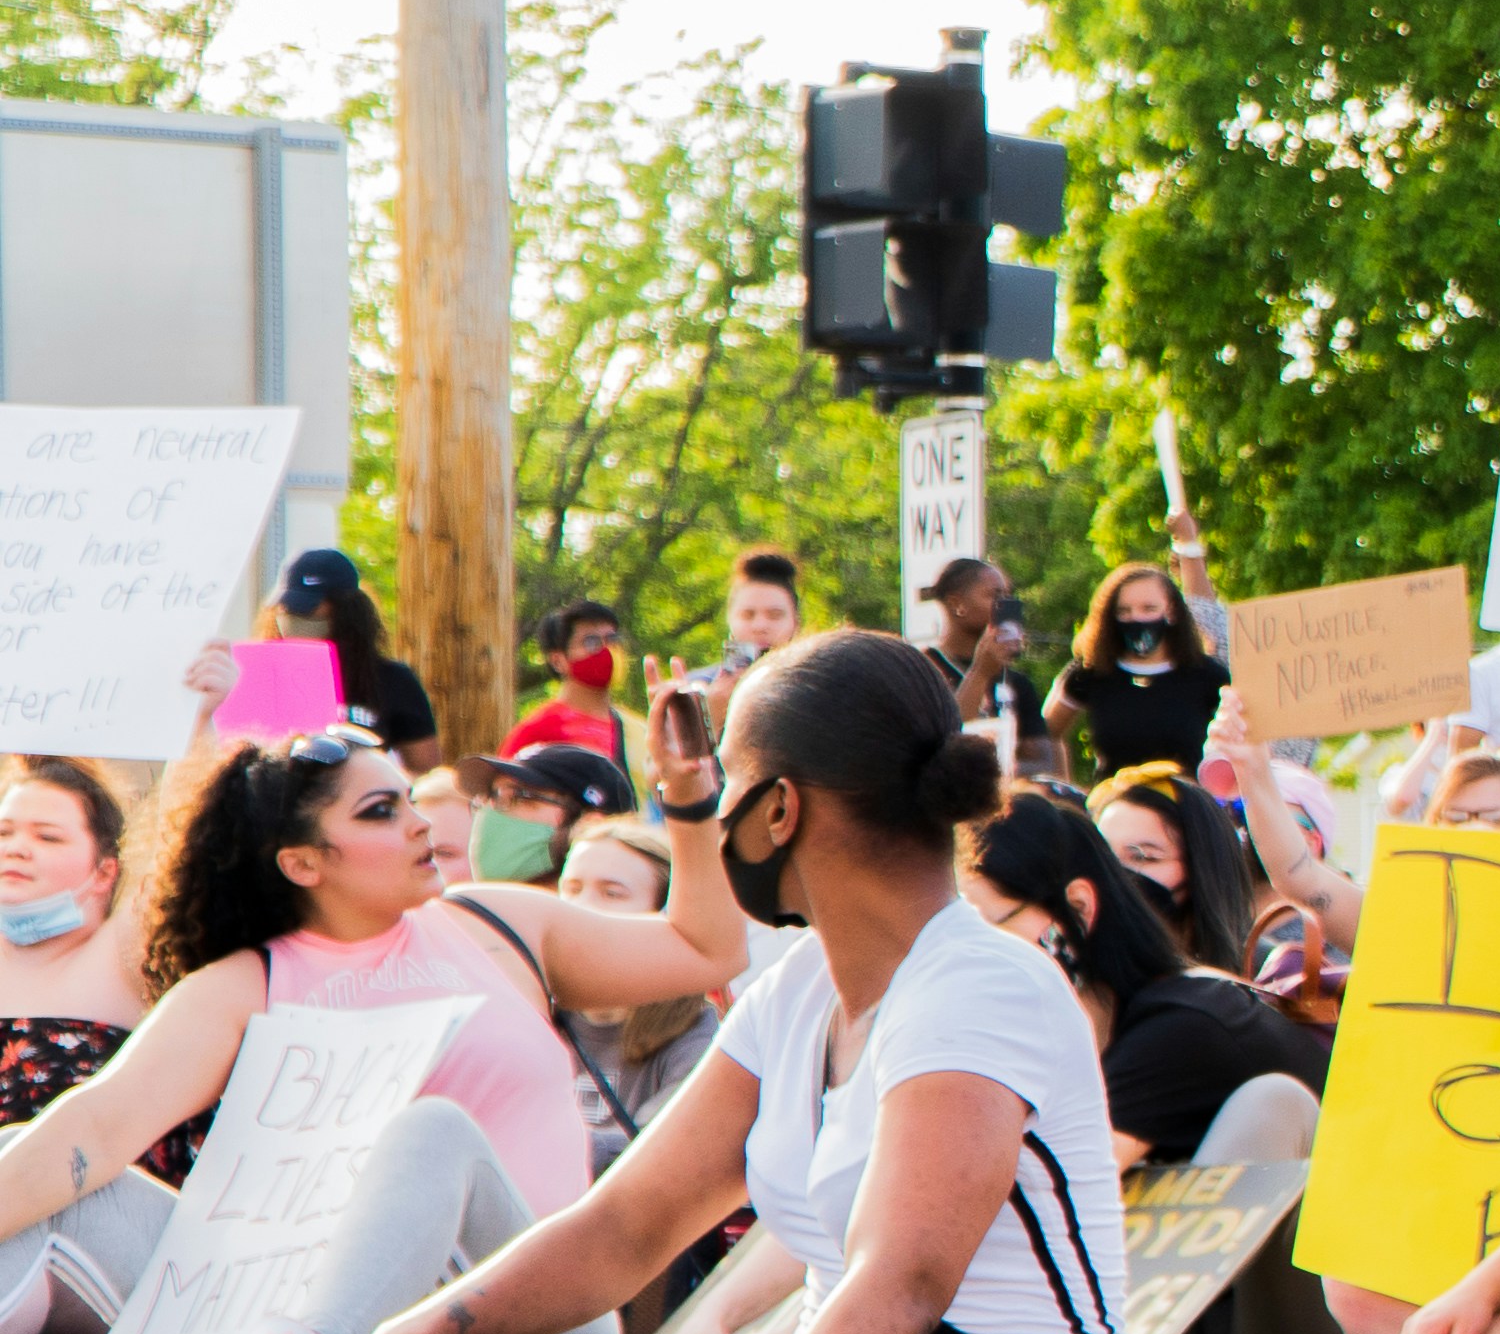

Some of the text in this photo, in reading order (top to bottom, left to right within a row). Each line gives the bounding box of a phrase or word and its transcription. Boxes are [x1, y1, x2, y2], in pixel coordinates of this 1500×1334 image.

[26, 424, 271, 465] are neutral
[911, 435, 965, 487] ONE
[0, 479, 185, 525] tions of
[78, 533, 162, 567] have
[910, 499, 965, 555] WAY
[1, 570, 222, 616] side of the
[1276, 652, 1318, 708] NO
[256, 1038, 425, 1134] BLACK
